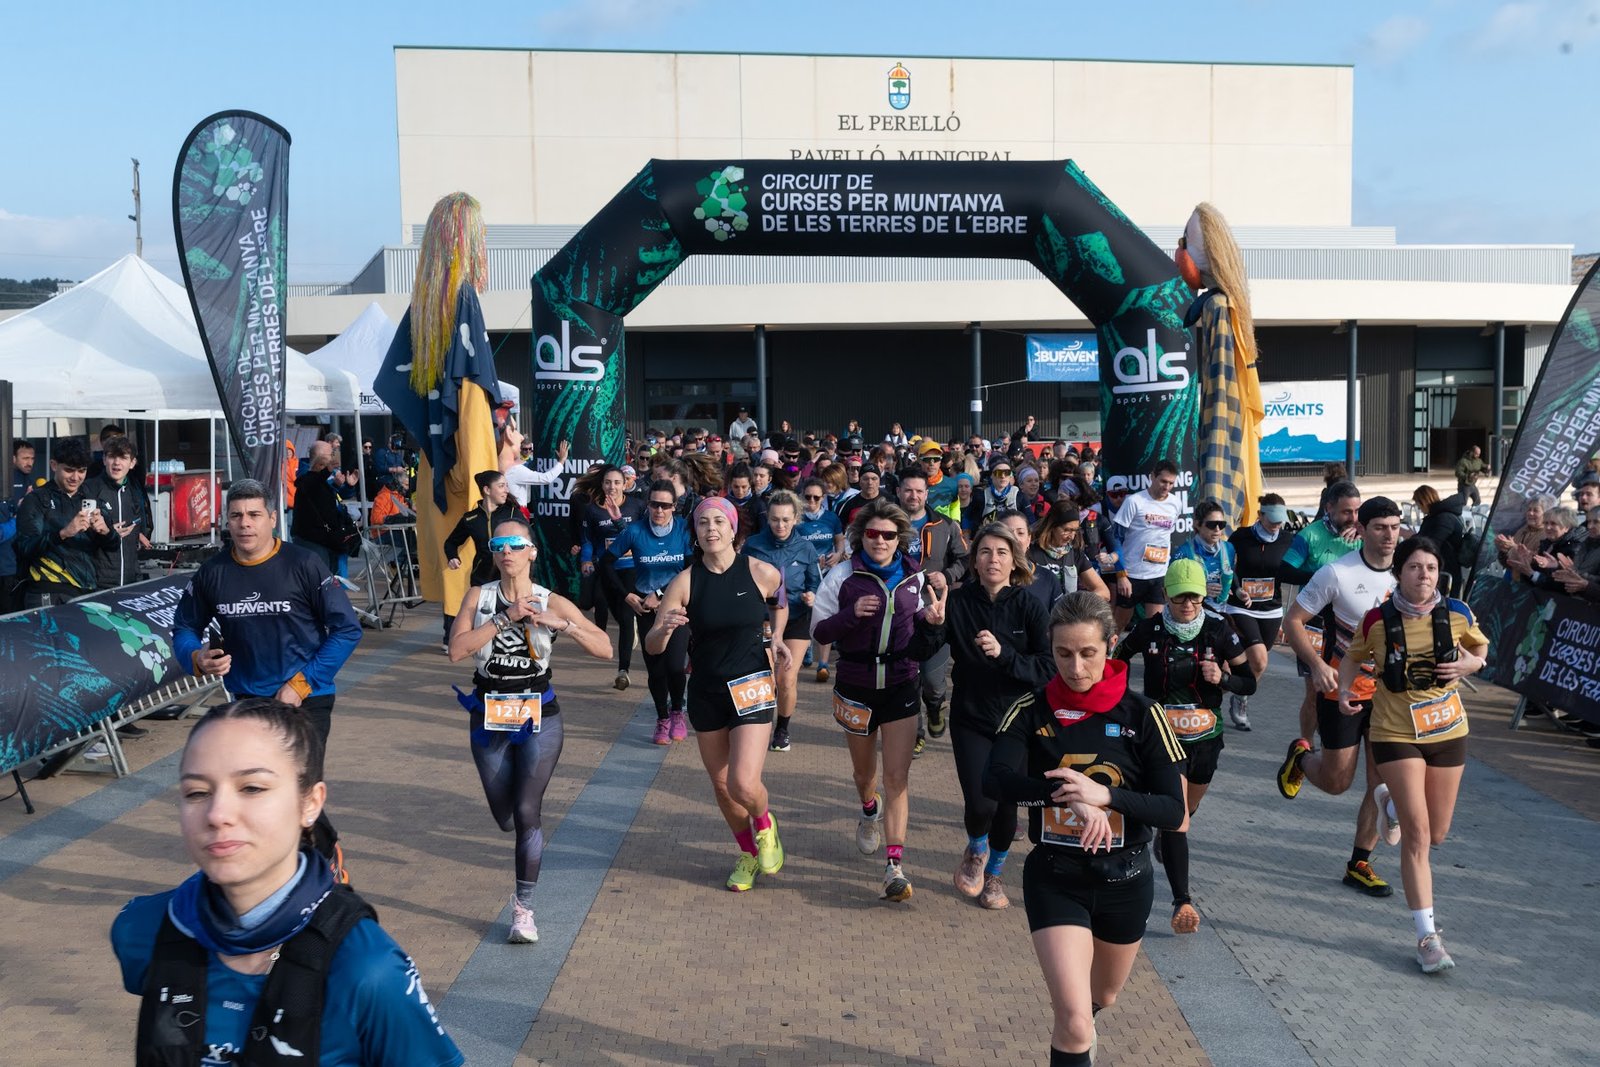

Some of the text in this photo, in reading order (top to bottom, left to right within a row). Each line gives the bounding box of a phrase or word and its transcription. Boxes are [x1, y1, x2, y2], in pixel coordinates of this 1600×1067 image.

[838, 111, 961, 132] EL PERELLÓ
[761, 173, 874, 190] CIRCUIT DE
[760, 192, 1004, 213] CURSES PER MUNTANYA
[762, 214, 790, 232] DE
[794, 214, 831, 232] LES
[837, 214, 917, 233] TERRES
[922, 214, 950, 233] DE
[257, 273, 275, 298] DE
[238, 231, 275, 445] CURSES PER MUTANYA
[535, 320, 605, 381] als
[1038, 350, 1099, 363] BUFAVEN
[1113, 328, 1189, 394] als
[537, 383, 602, 392] sport shop
[237, 349, 259, 448] CIRCUIT DE
[1116, 392, 1189, 405] sport shop
[1265, 403, 1324, 416] FAVENTS
[1563, 405, 1591, 440] PER
[1509, 410, 1569, 494] CIRCUIT DE
[1555, 456, 1580, 487] LES
[217, 600, 292, 615] BUFAVENTS
[1539, 660, 1559, 684] DE
[738, 683, 772, 702] 1049
[495, 704, 531, 719] 1212
[1171, 713, 1211, 729] 1003
[1422, 704, 1456, 727] 1251
